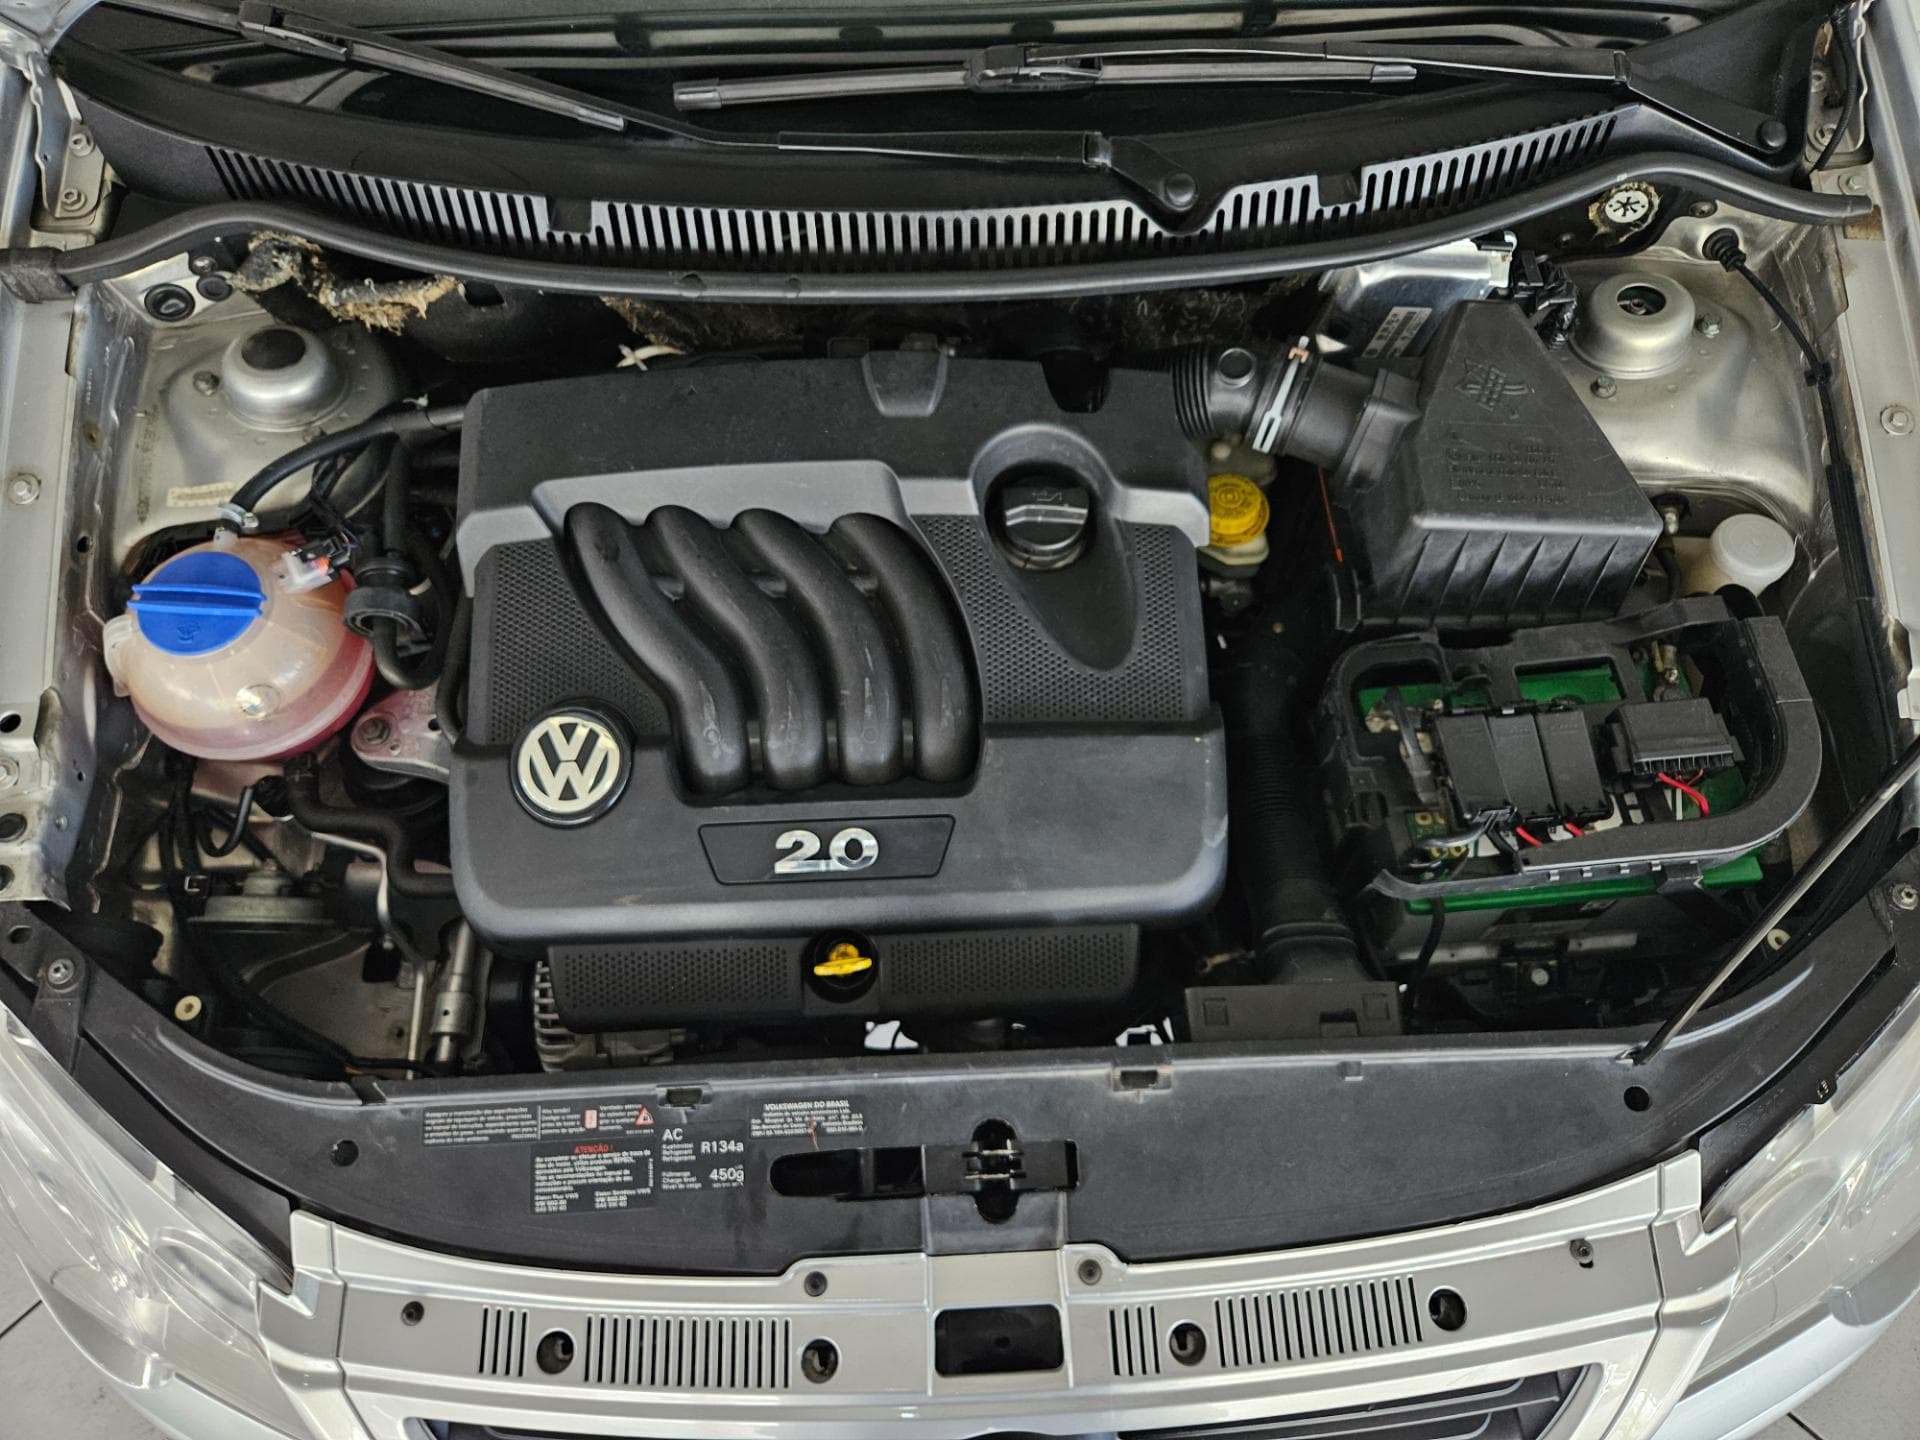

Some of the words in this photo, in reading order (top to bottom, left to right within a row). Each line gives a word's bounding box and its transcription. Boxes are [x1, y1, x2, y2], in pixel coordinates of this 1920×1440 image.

[517, 715, 620, 814] VW
[774, 827, 878, 875] 2.0
[662, 1127, 683, 1141] AC
[701, 1140, 744, 1154] R134a
[709, 1167, 744, 1182] 450g
